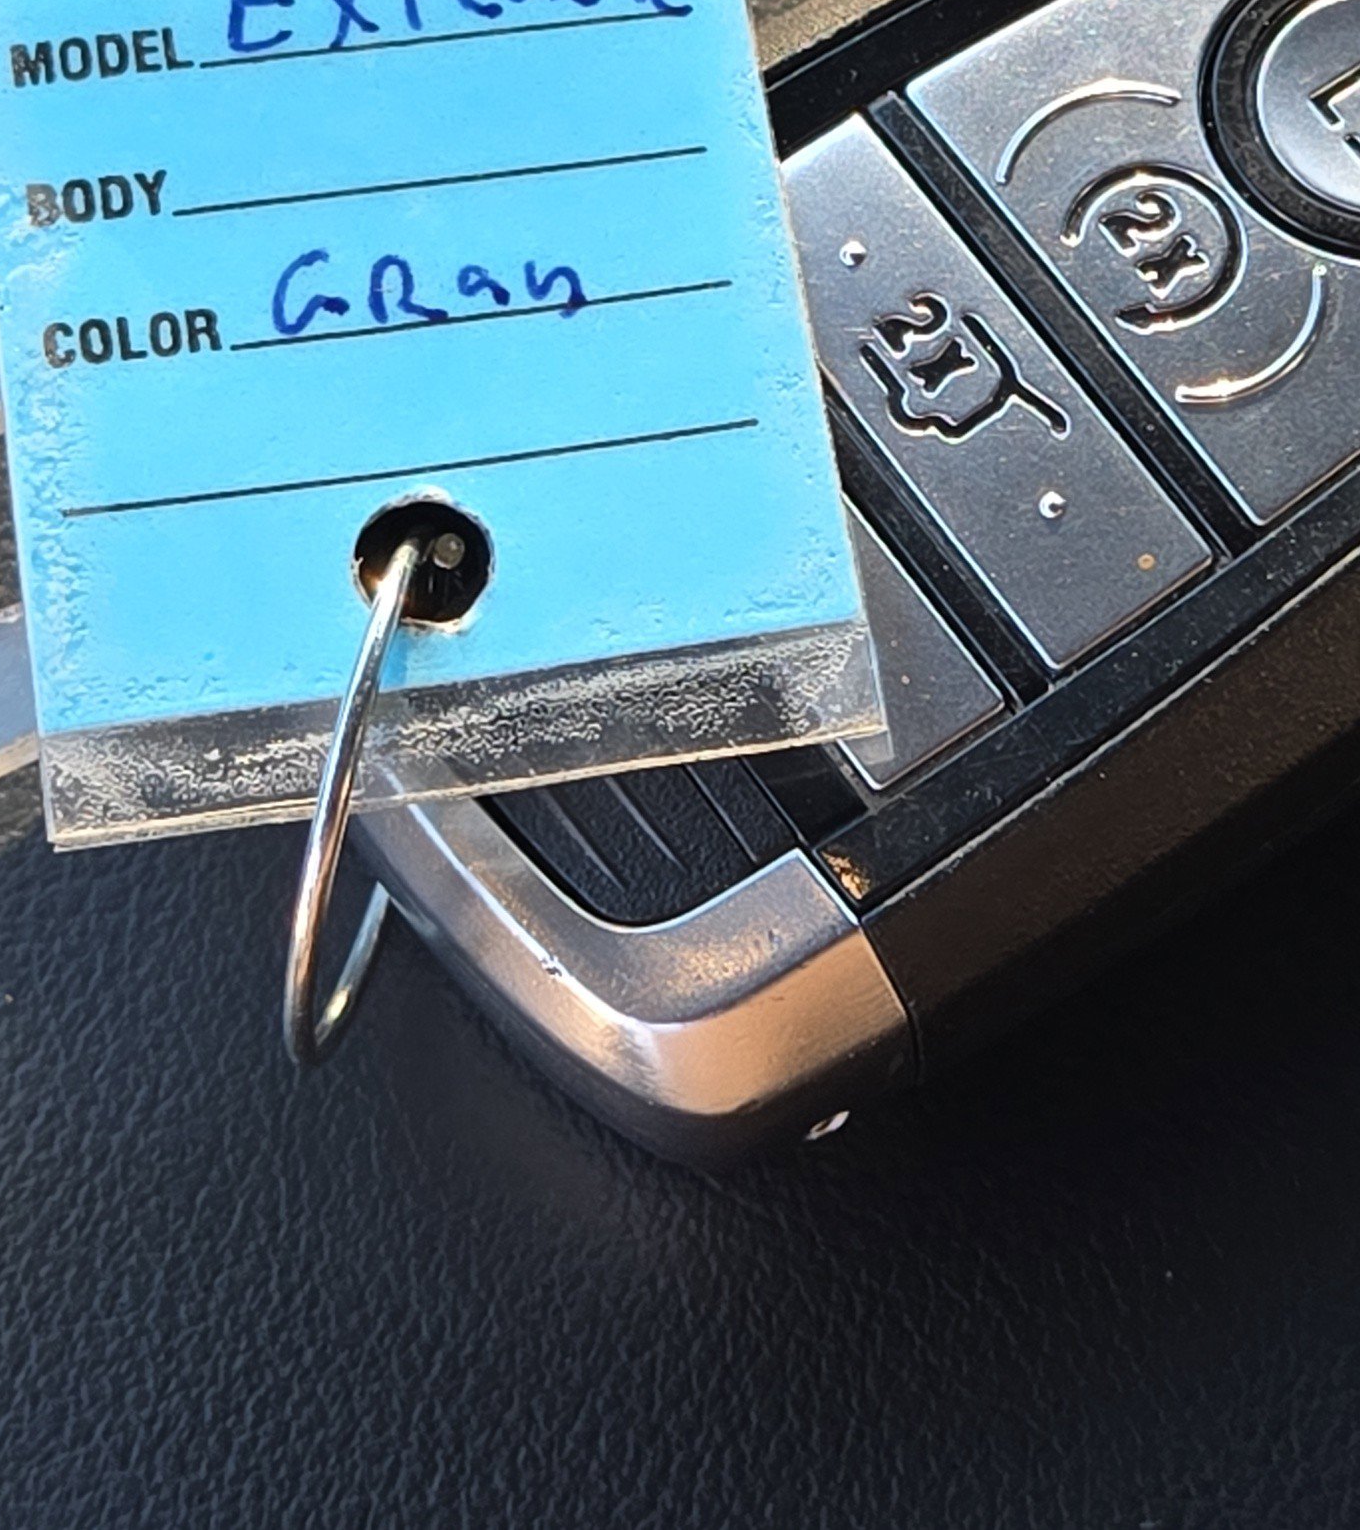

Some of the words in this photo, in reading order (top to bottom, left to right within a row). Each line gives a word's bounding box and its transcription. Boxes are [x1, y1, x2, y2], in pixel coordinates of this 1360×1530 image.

[10, 27, 194, 88] MODEL
[26, 169, 167, 226] BODY
[43, 308, 222, 368] COLOR
